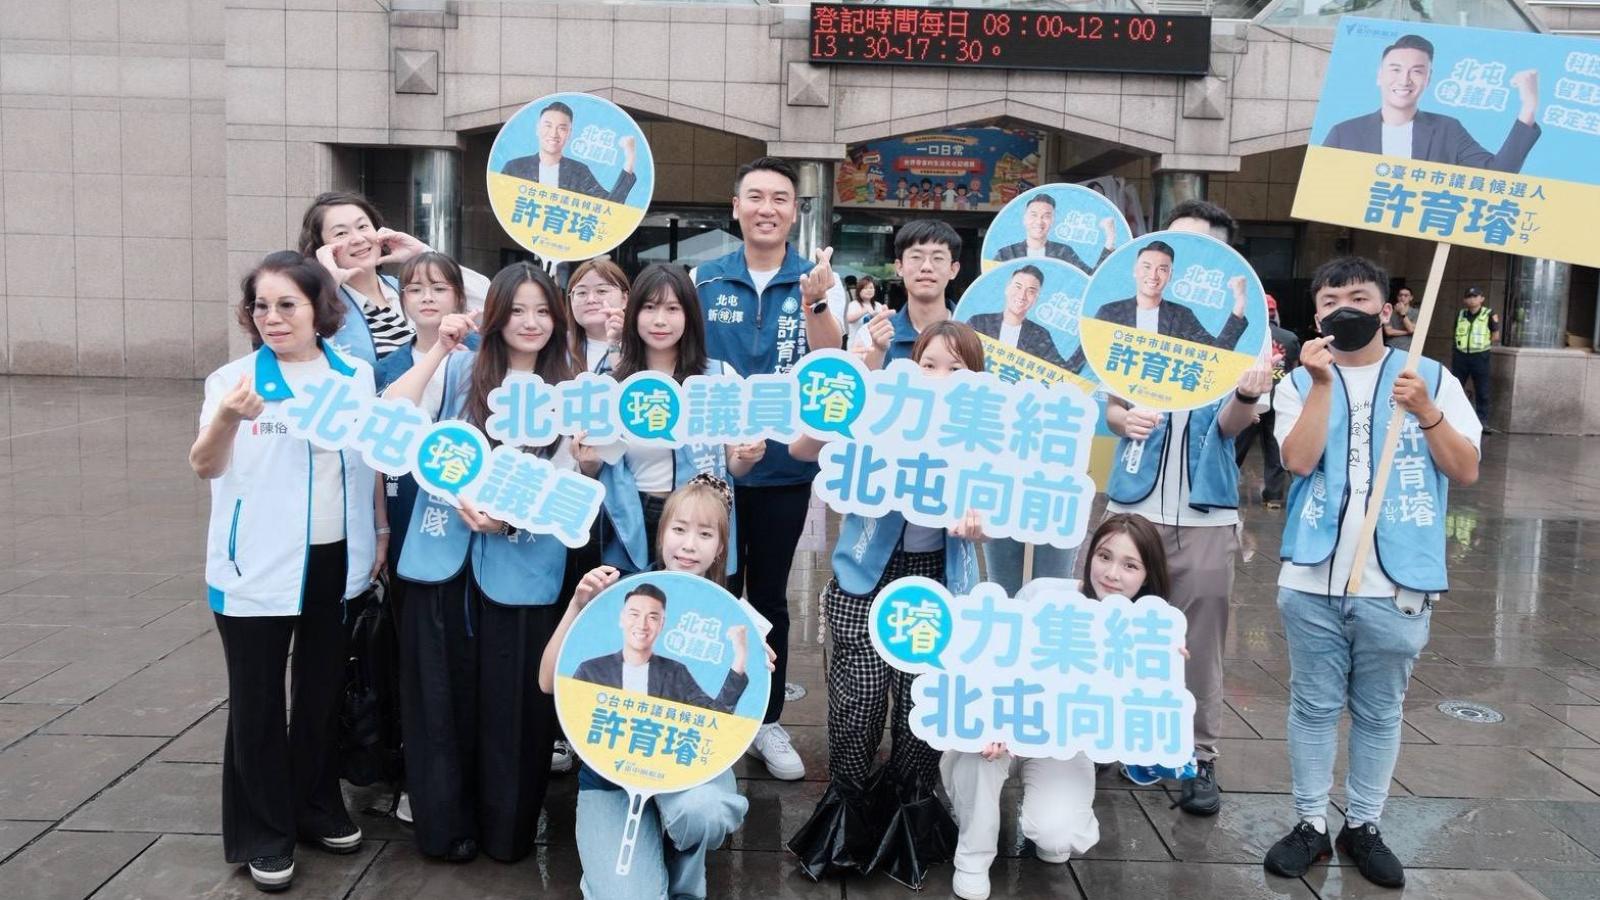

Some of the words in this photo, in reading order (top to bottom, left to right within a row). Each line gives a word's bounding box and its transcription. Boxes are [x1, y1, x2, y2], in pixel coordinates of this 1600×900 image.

[814, 8, 970, 37] 登記時間每日
[1454, 60, 1504, 86] 北屯
[582, 127, 616, 146] 北屯
[916, 145, 964, 156] 一口日常
[1391, 164, 1546, 200] 臺中市議員候選人
[528, 187, 612, 216] 台中市議員候選人
[1364, 182, 1521, 246] 許育璿
[511, 197, 598, 242] 許育璿
[1184, 266, 1223, 289] 北屯
[715, 294, 738, 306] 北屯
[1124, 331, 1220, 364] 台中市議員候選人
[1105, 342, 1205, 392] 許育璿
[494, 380, 795, 438] 北屯璿議員
[802, 370, 1085, 468] 璿力集結
[825, 443, 1084, 537] 北屯向前
[680, 613, 722, 638] 北屯
[887, 596, 1173, 681] 璿力集結
[609, 695, 719, 730] 台中市議員候選人
[921, 673, 1184, 755] 北屯向前
[586, 708, 701, 767] 許育璿
